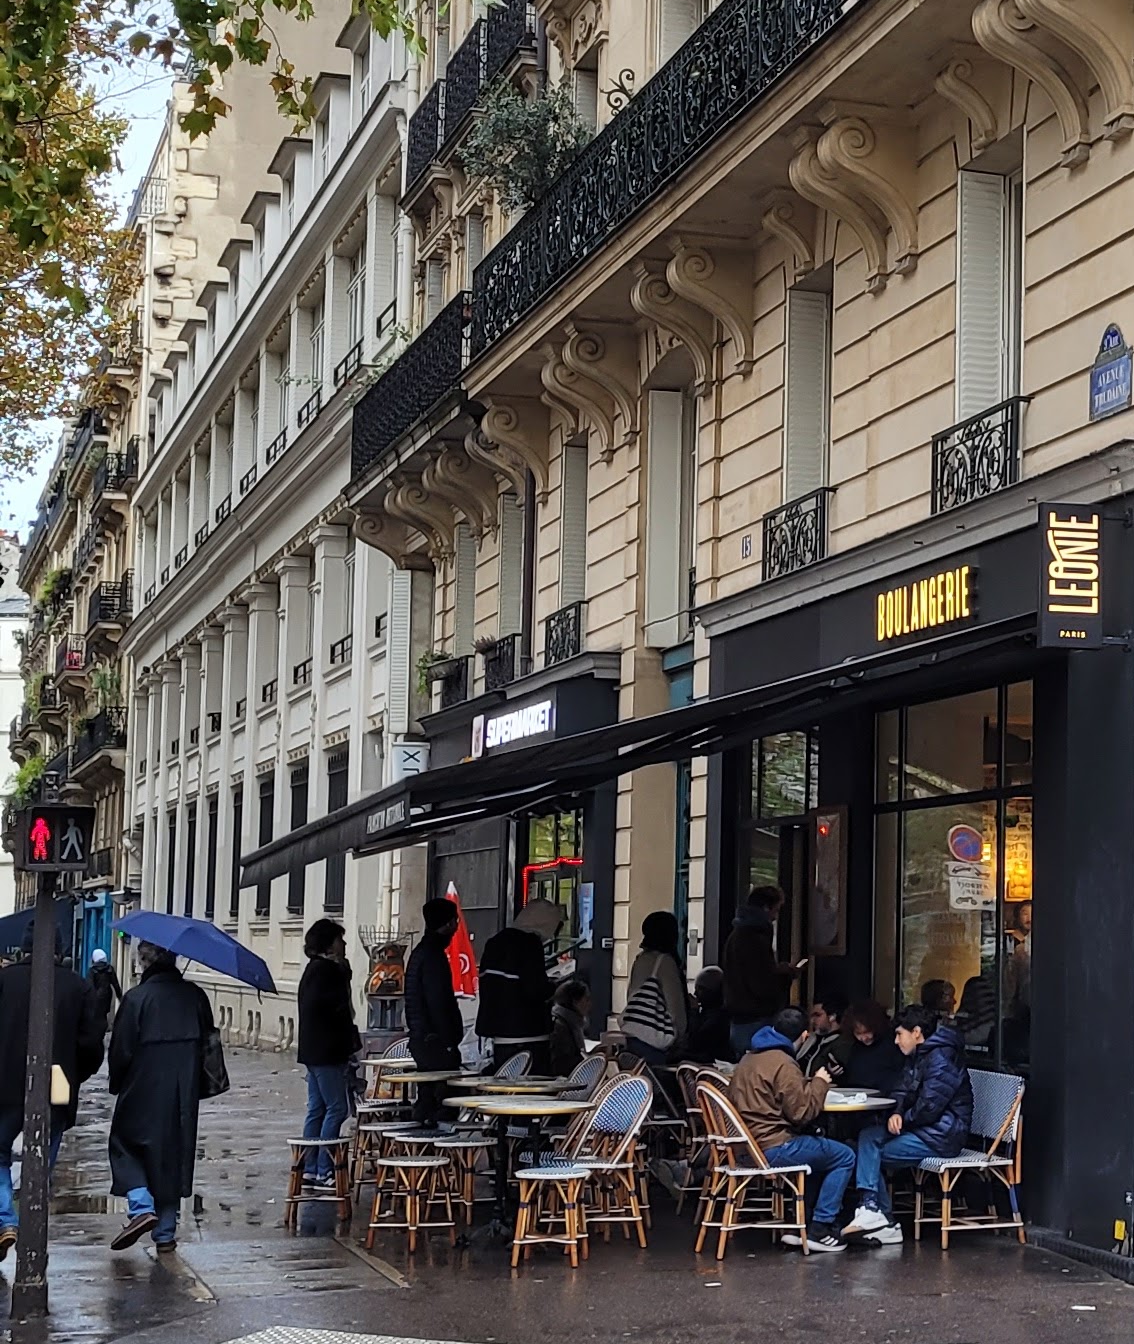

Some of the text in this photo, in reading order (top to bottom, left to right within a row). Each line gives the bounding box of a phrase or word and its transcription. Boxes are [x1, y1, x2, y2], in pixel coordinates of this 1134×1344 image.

[743, 536, 751, 558] 15
[877, 565, 970, 642] BOULANGERIE
[1059, 630, 1086, 639] PARIS
